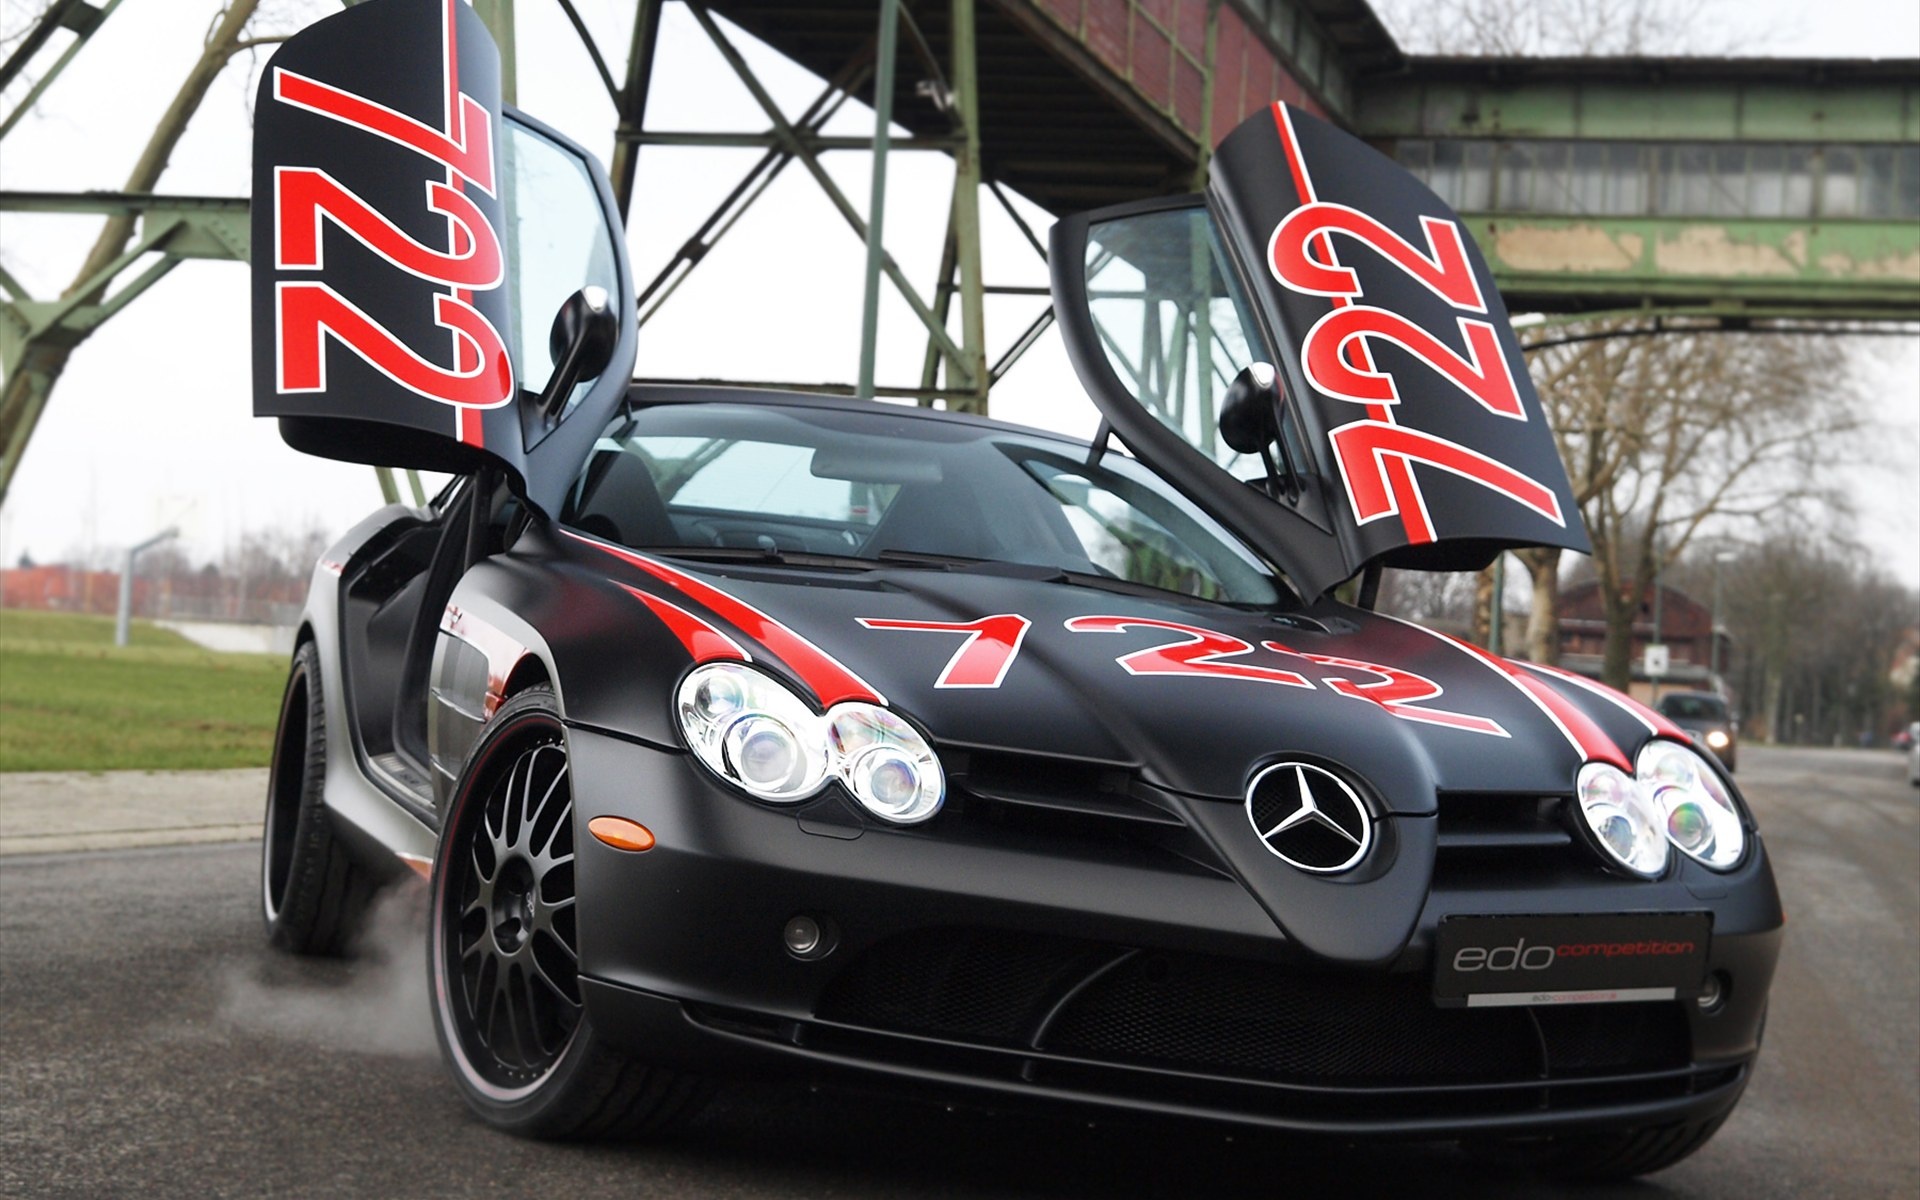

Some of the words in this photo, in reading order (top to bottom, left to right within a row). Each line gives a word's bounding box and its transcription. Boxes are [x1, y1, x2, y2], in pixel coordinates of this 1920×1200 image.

[273, 66, 514, 409] 722
[1267, 201, 1566, 528] 722
[1453, 938, 1555, 972] edo
[1556, 940, 1694, 959] competition
